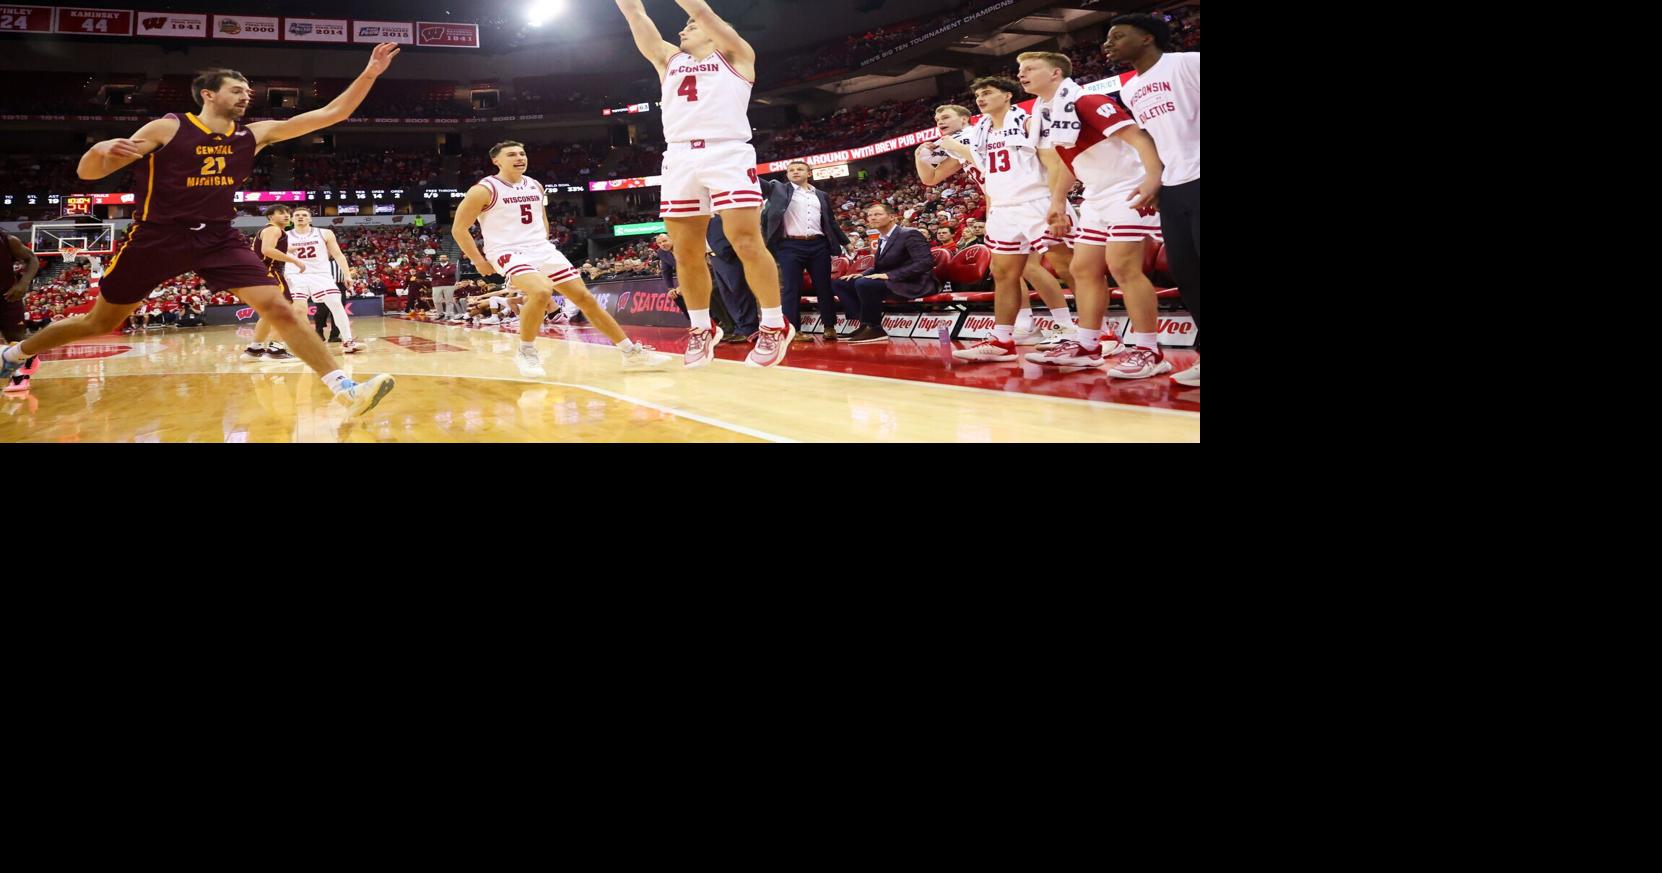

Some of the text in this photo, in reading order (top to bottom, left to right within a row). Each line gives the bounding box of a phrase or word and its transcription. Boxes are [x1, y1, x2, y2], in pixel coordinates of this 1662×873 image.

[0, 15, 27, 29] 24
[70, 11, 120, 19] KAMINSKY
[82, 18, 107, 32] 44
[895, 43, 909, 53] TEN
[910, 20, 963, 46] TOURNAMENT
[963, 0, 1015, 24] CHAMPIONS
[677, 75, 698, 102] 4
[196, 145, 234, 155] CENTRAL
[807, 151, 849, 167] AROUND
[850, 144, 875, 159] WITH
[875, 137, 898, 151] BREW
[898, 131, 916, 145] PUB
[916, 127, 942, 140] PIZZA
[201, 157, 226, 175] 21
[988, 149, 1010, 174] 13
[502, 195, 541, 204] WISCONSIN
[67, 204, 88, 214] 24
[520, 203, 533, 225] 5
[297, 246, 317, 259] 22
